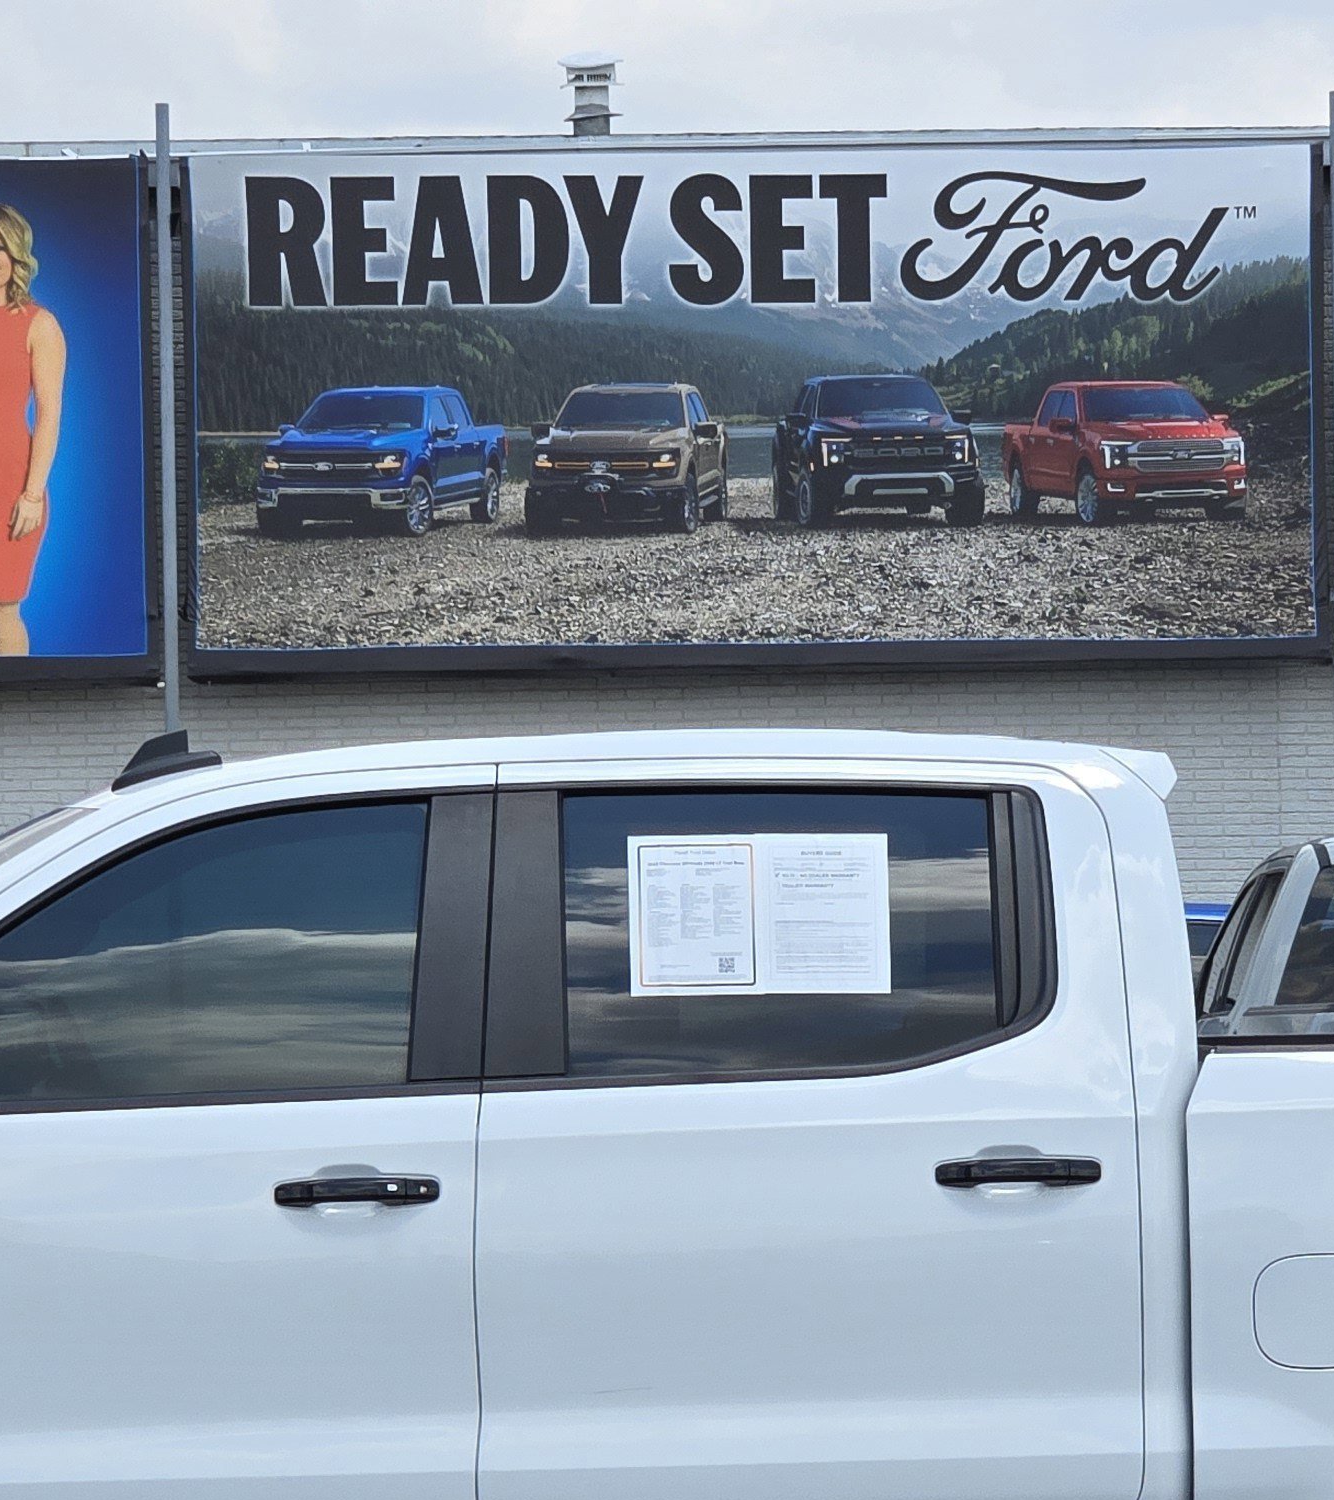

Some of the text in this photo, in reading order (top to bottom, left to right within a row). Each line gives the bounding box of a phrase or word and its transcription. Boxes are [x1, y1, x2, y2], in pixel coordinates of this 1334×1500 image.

[245, 174, 645, 306] READY
[668, 173, 886, 305] SET
[899, 171, 1229, 305] Ford
